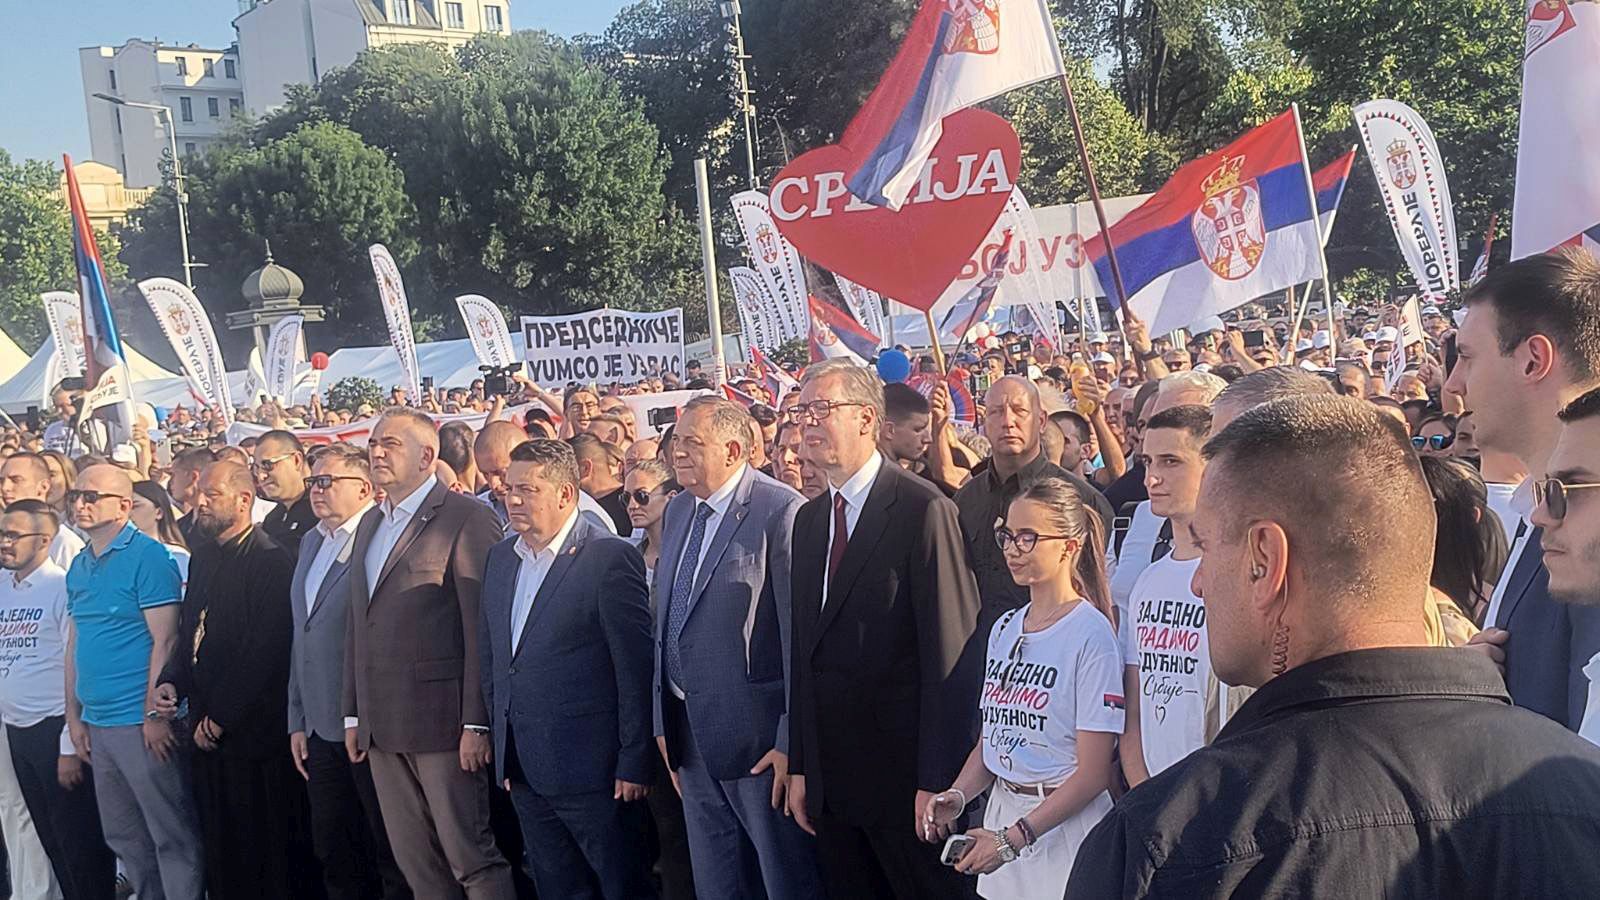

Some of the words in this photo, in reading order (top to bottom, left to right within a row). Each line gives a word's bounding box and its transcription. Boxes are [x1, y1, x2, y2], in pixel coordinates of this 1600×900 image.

[769, 148, 1012, 222] СРИЈА
[525, 315, 680, 350] ПРЕДСЕДНИЧЕ
[529, 355, 599, 382] YUMCO
[604, 354, 624, 378] ЈЕ
[1137, 600, 1206, 628] ЗАЈЕДНО
[1144, 674, 1183, 704] Србије
